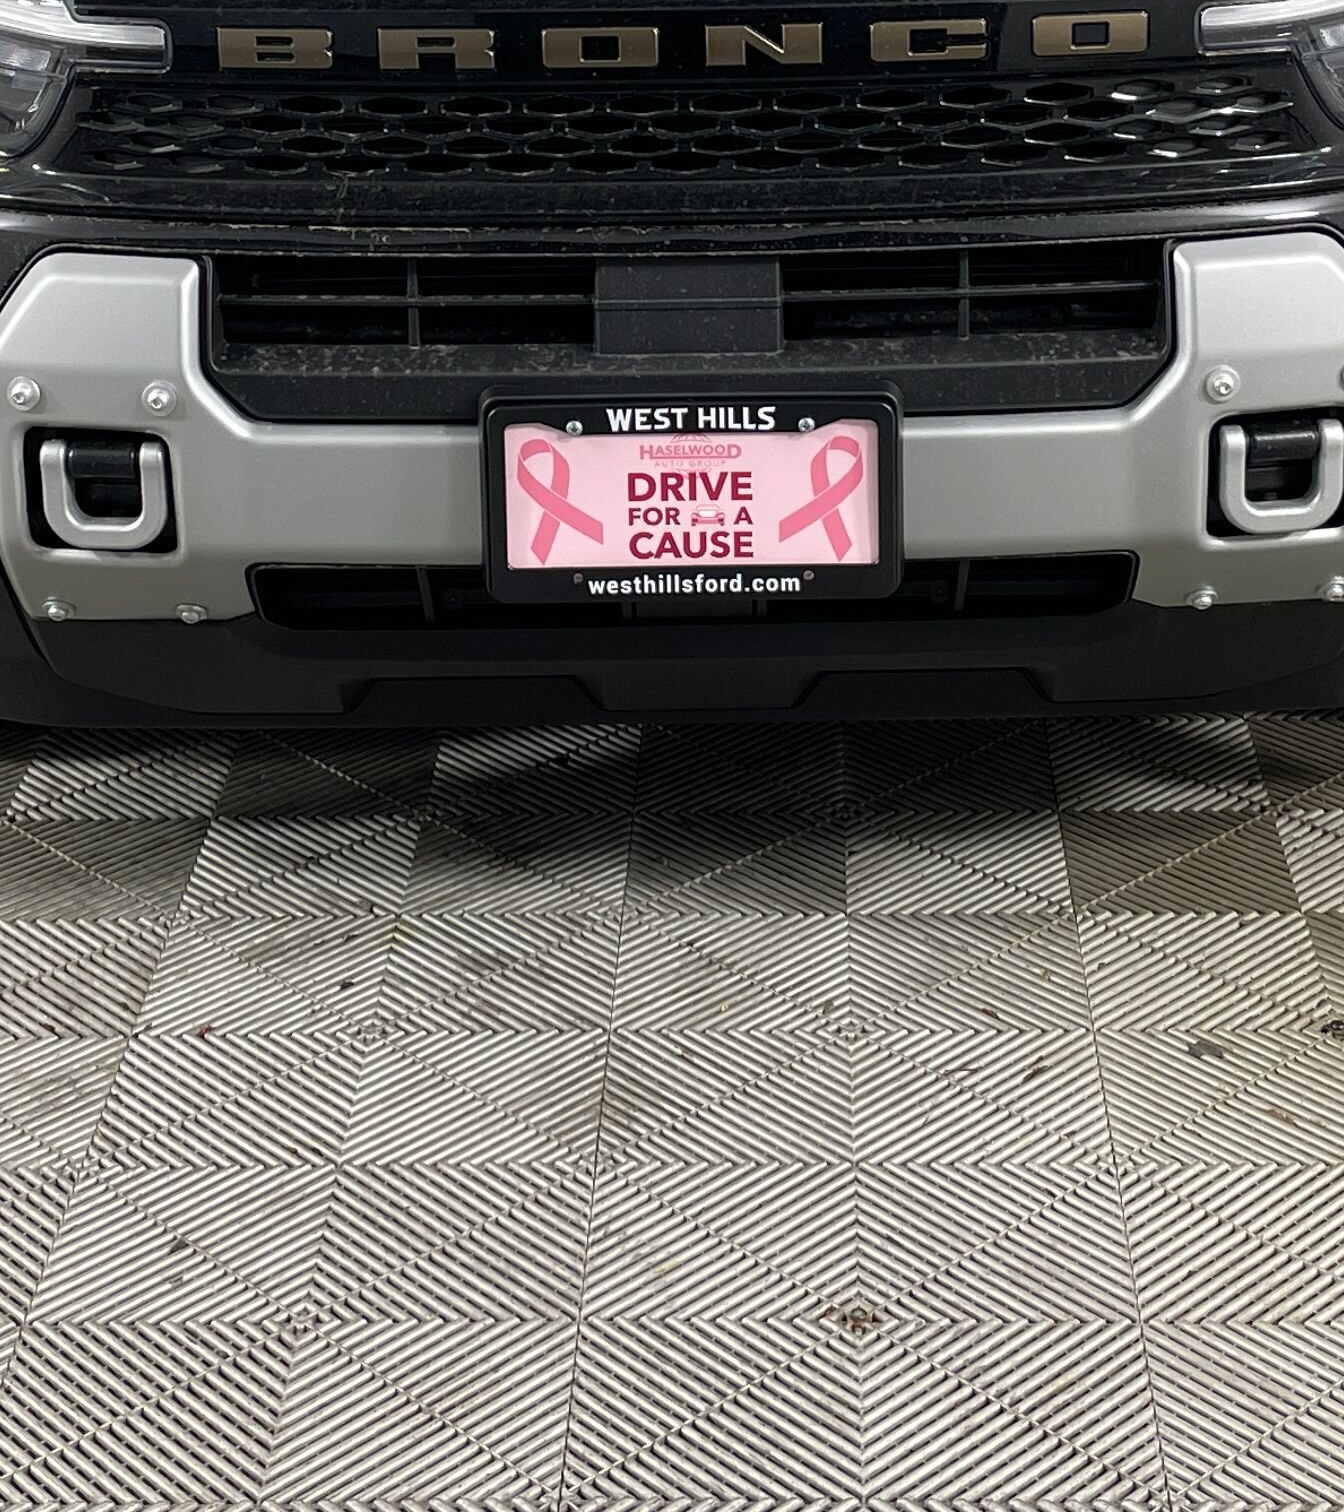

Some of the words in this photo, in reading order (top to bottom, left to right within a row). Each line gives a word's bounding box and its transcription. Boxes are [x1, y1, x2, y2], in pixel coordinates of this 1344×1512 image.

[218, 11, 1149, 69] BRONCO
[605, 407, 689, 433] WEST
[697, 406, 777, 431] HILLS
[639, 443, 742, 460] HASELWOOD
[627, 471, 754, 503] DRIVE
[628, 507, 682, 527] FOR
[733, 506, 754, 526] A
[628, 531, 755, 560] CAUSE
[587, 573, 802, 596] westhillsford.com
